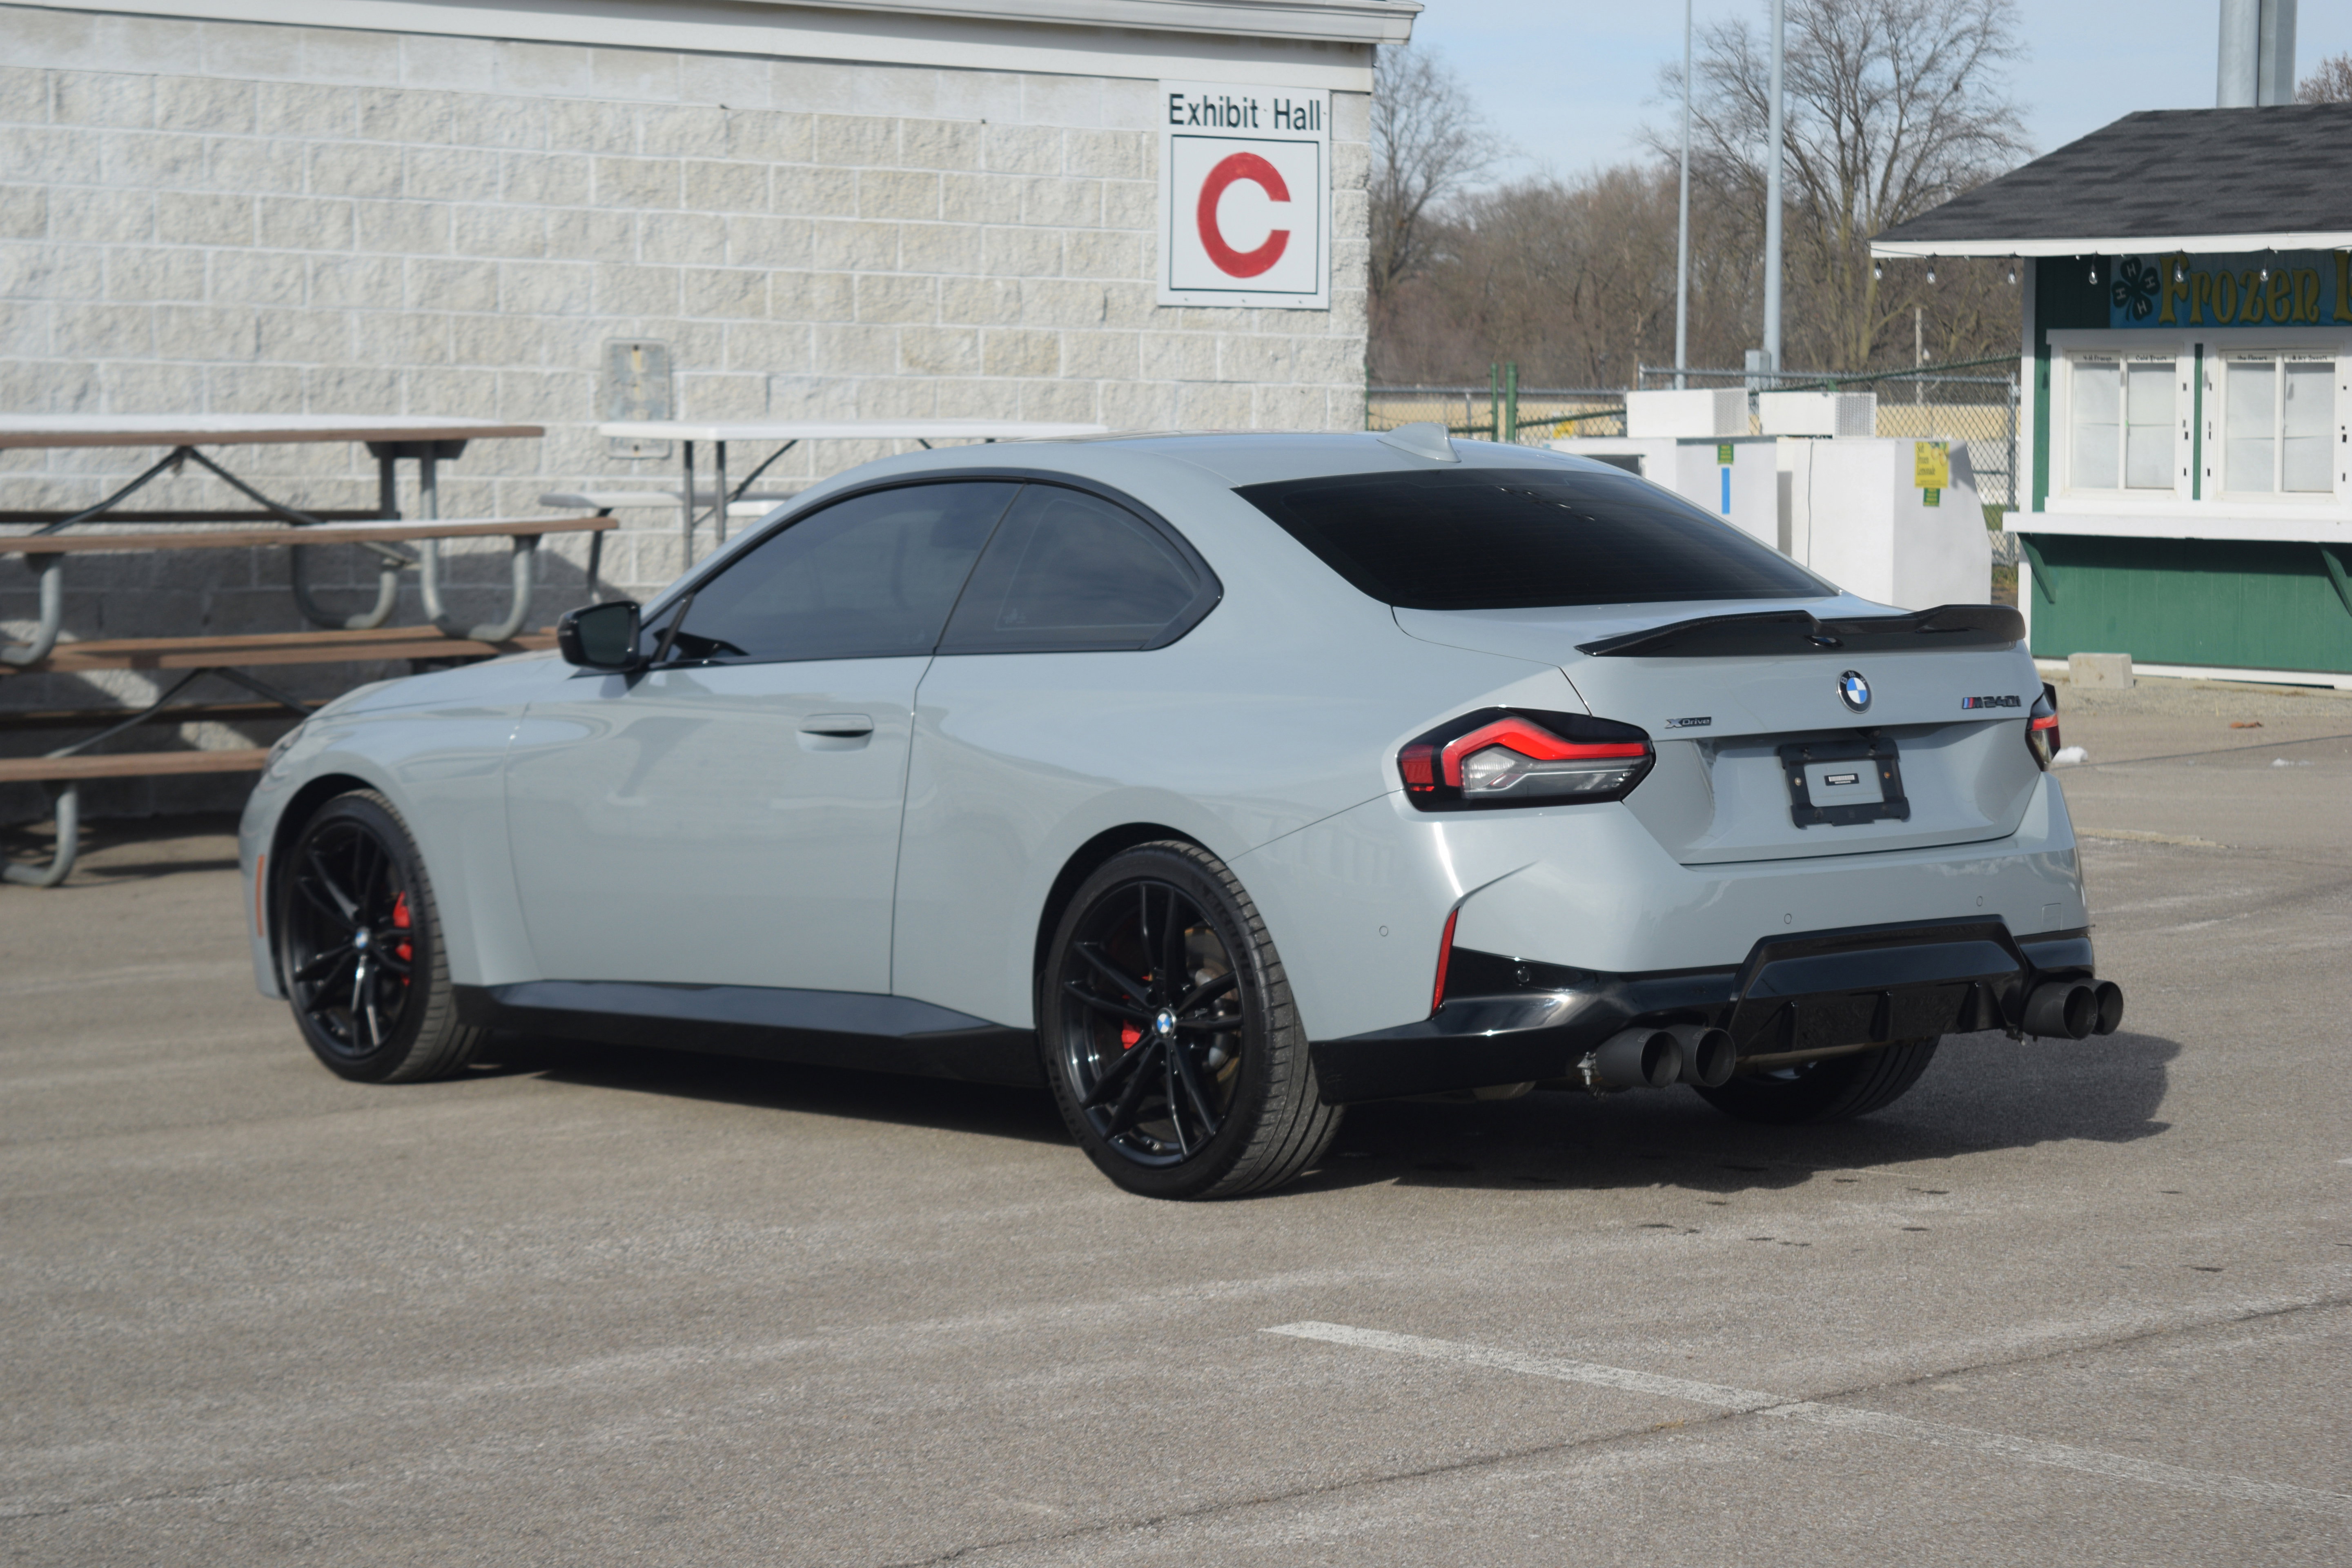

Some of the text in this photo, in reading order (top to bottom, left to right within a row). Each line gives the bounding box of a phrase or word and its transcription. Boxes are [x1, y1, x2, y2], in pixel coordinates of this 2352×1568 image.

[1169, 94, 1321, 131] Exhibit Hall
[1197, 151, 1291, 279] C
[2158, 252, 2321, 325] Frozen
[1840, 671, 1866, 685] BMW
